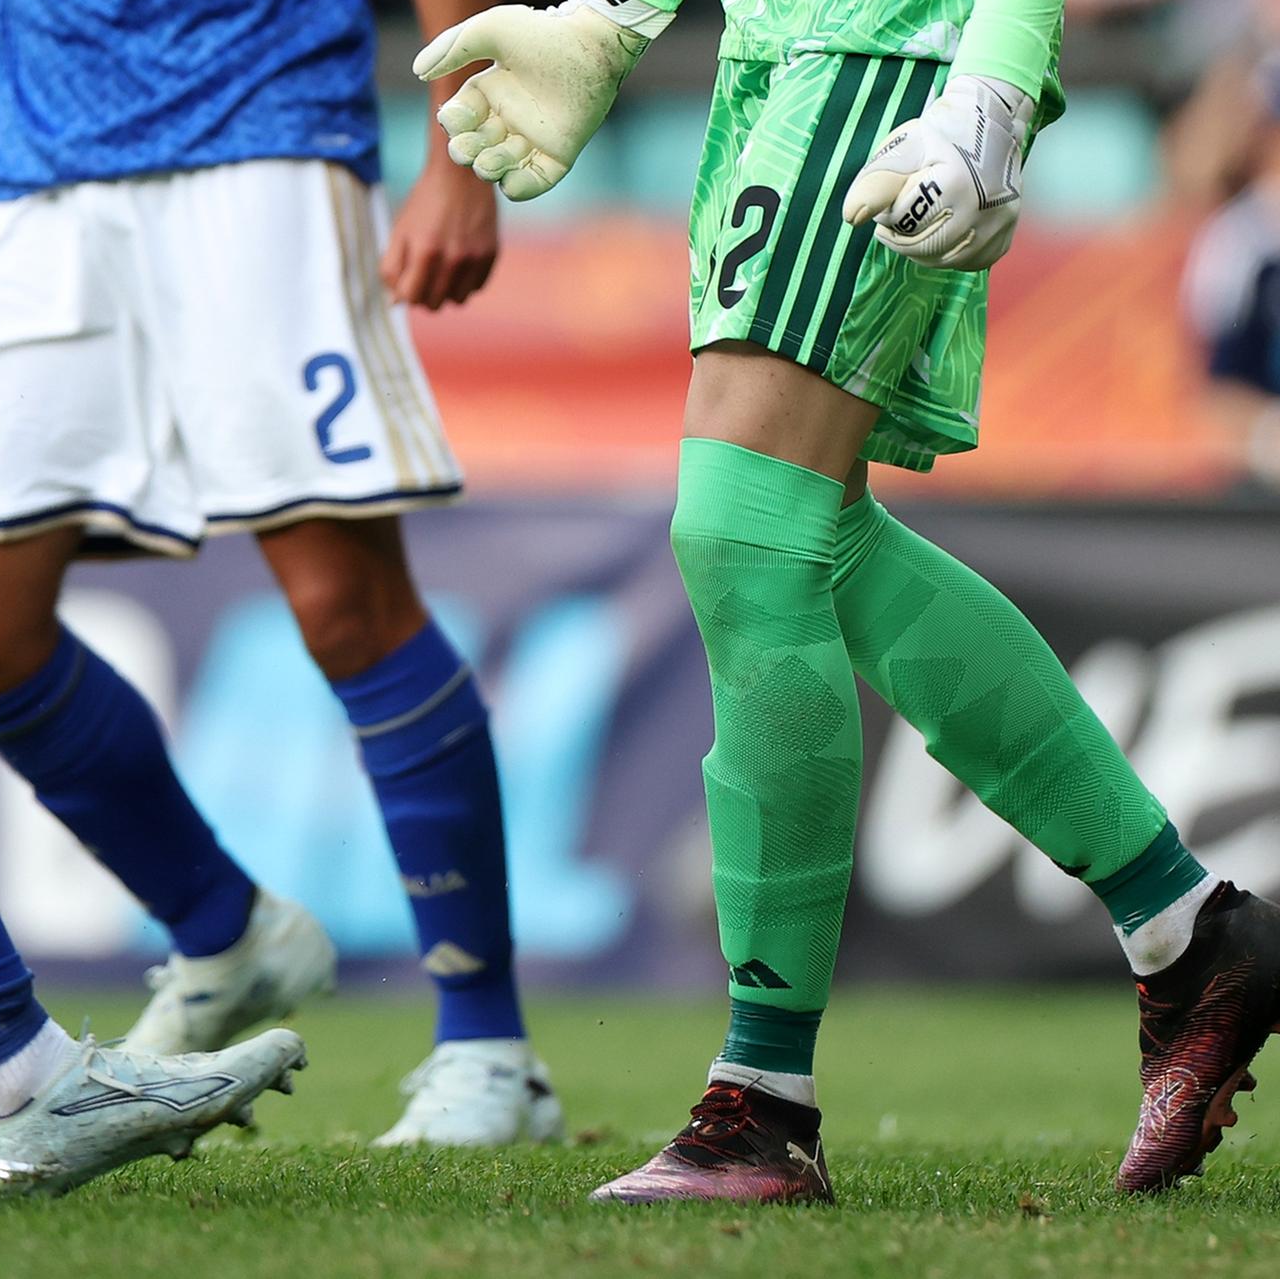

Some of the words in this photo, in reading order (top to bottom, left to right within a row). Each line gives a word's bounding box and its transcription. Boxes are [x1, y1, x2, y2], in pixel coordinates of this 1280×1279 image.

[705, 185, 782, 310] 2
[893, 180, 943, 234] sch
[303, 352, 372, 464] 2
